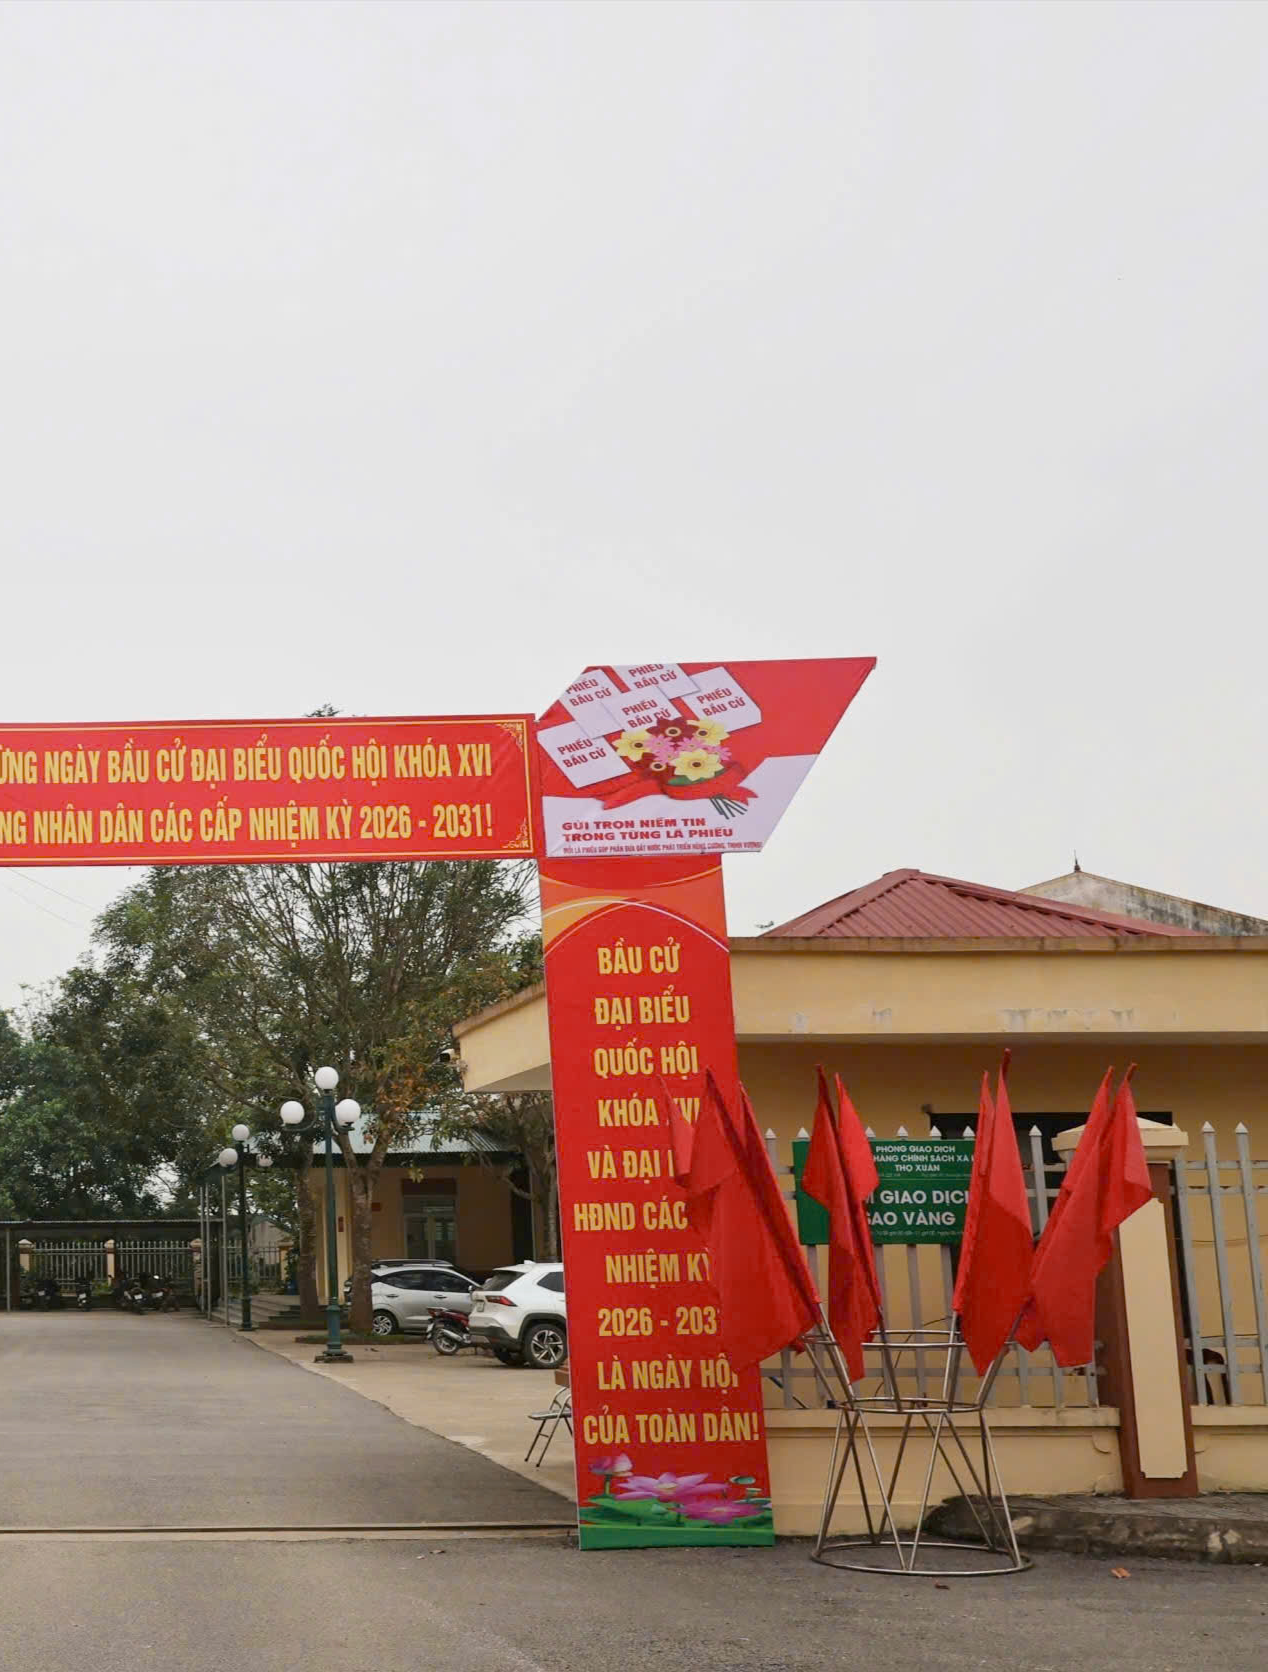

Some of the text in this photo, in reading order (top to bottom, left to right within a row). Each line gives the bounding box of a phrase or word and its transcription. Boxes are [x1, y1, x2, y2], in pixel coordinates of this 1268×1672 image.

[44, 743, 101, 784] NGÀY
[108, 738, 149, 783] BẦU
[156, 737, 187, 782] CỬ
[191, 748, 226, 790] ĐẠI
[233, 733, 281, 780] BIỂU
[288, 734, 345, 784] QUỐC
[352, 738, 387, 786] HỘI
[394, 738, 452, 778] KHÓA
[457, 743, 492, 777] XVI
[34, 804, 93, 844] NHÂN
[100, 803, 143, 843] DÂN
[151, 802, 193, 843] CÁC
[200, 796, 242, 842] CẤP
[249, 800, 320, 848] NHIỆM
[326, 799, 353, 839] KỲ
[359, 805, 412, 839] 2026
[418, 819, 426, 828] -
[433, 804, 493, 838] 2031!
[562, 832, 615, 842] TRONG
[681, 817, 706, 827] TIN
[598, 936, 680, 975] BẦU CỬ
[595, 985, 690, 1030] ĐẠI BIỂU
[594, 1037, 699, 1080] QUỐC HỘI
[598, 1092, 700, 1127] KHÓA VI
[587, 1145, 617, 1178] VÀ
[623, 1150, 661, 1184] ĐẠI
[909, 1145, 932, 1153] GIAO
[573, 1195, 688, 1232] HĐND CÁC
[880, 1190, 927, 1204] GIAO
[903, 1209, 956, 1225] VÀNG
[605, 1248, 680, 1289] NHIỆM
[597, 1306, 720, 1337] 2026 - 203
[597, 1355, 625, 1390] LÀ
[631, 1354, 693, 1389] NGÀY
[583, 1405, 759, 1444] CỦA TOÀN DÂN!
